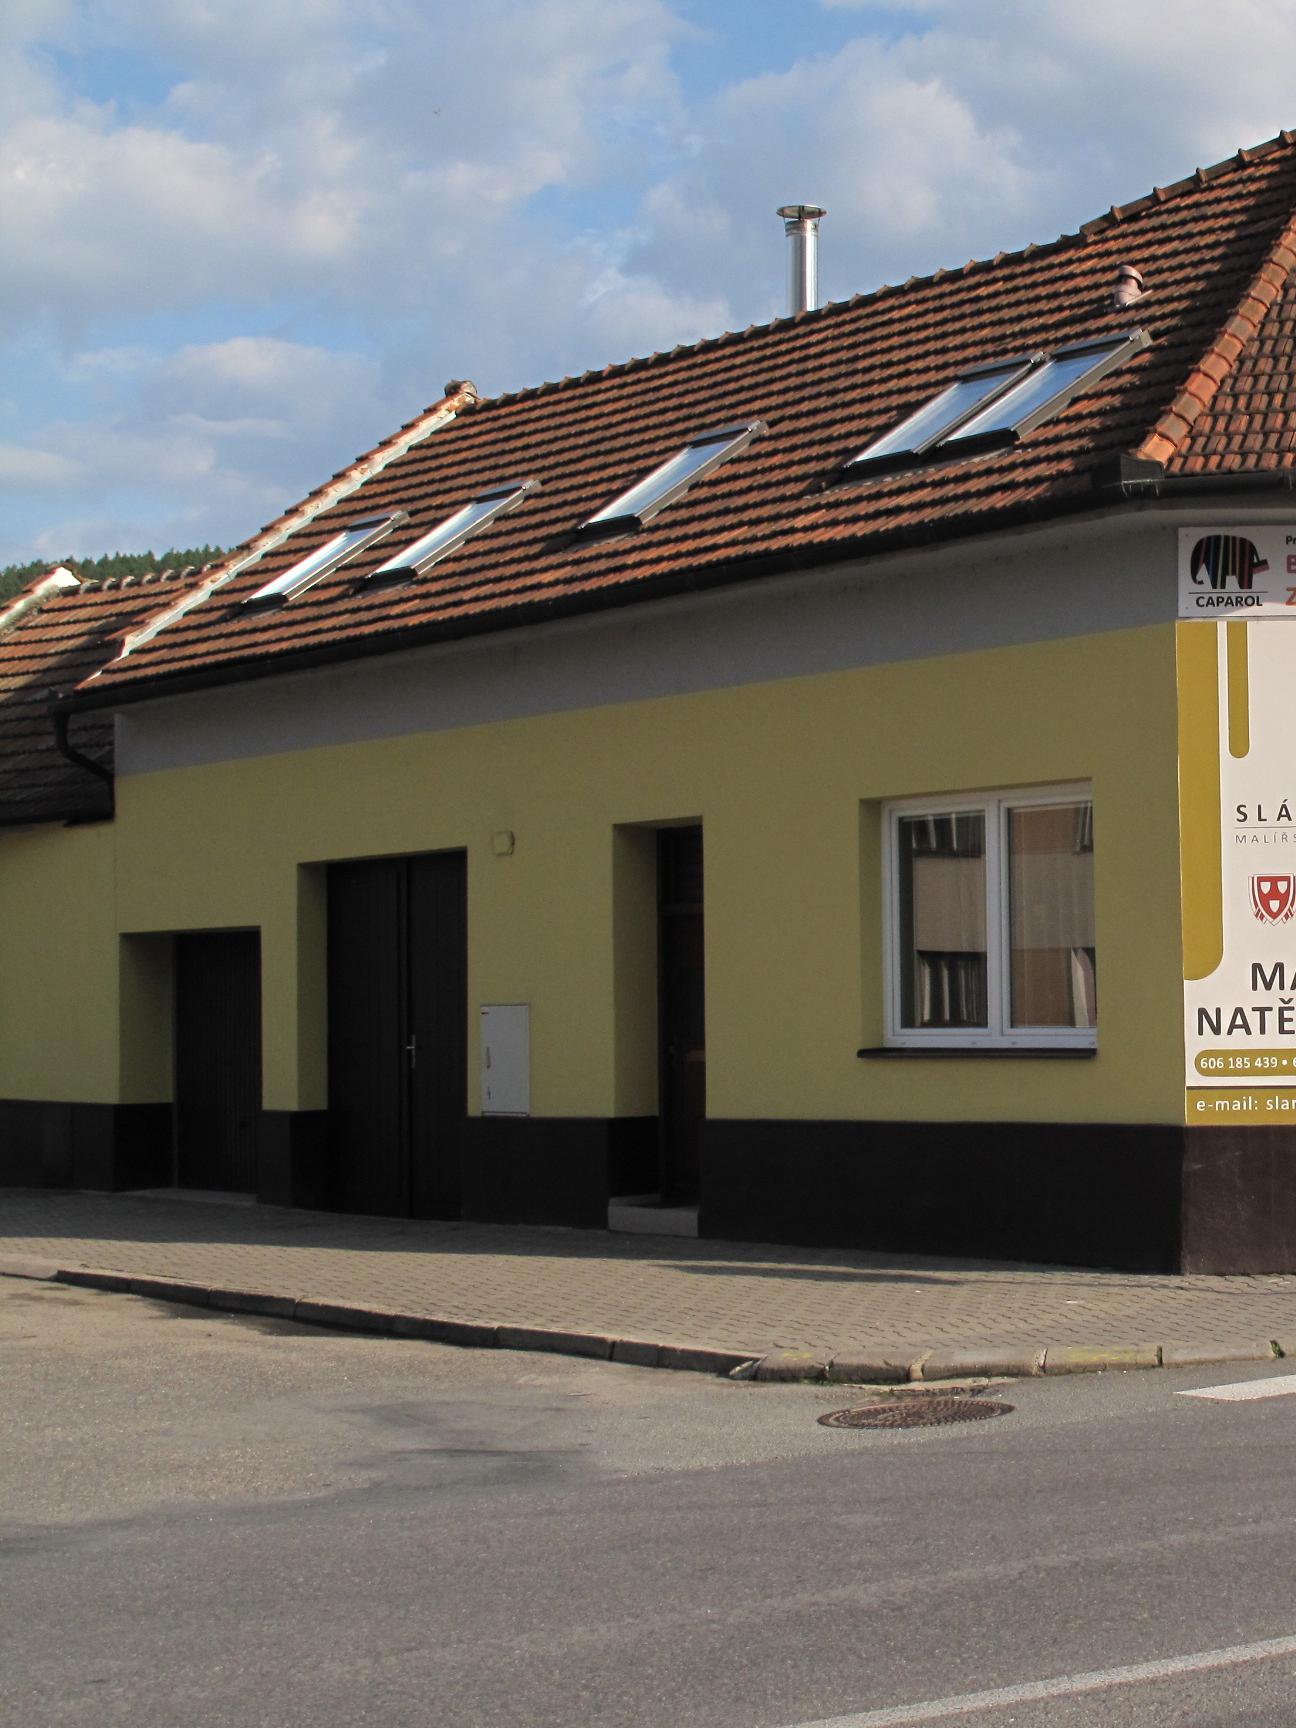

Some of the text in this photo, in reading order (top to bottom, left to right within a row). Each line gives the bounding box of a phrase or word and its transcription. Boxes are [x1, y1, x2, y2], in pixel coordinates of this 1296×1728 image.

[1195, 594, 1264, 609] CAPAROL
[1199, 1056, 1225, 1070] 606
[1228, 1056, 1251, 1069] 185
[1254, 1056, 1278, 1069] 439
[1195, 1095, 1259, 1112] e-mail:
